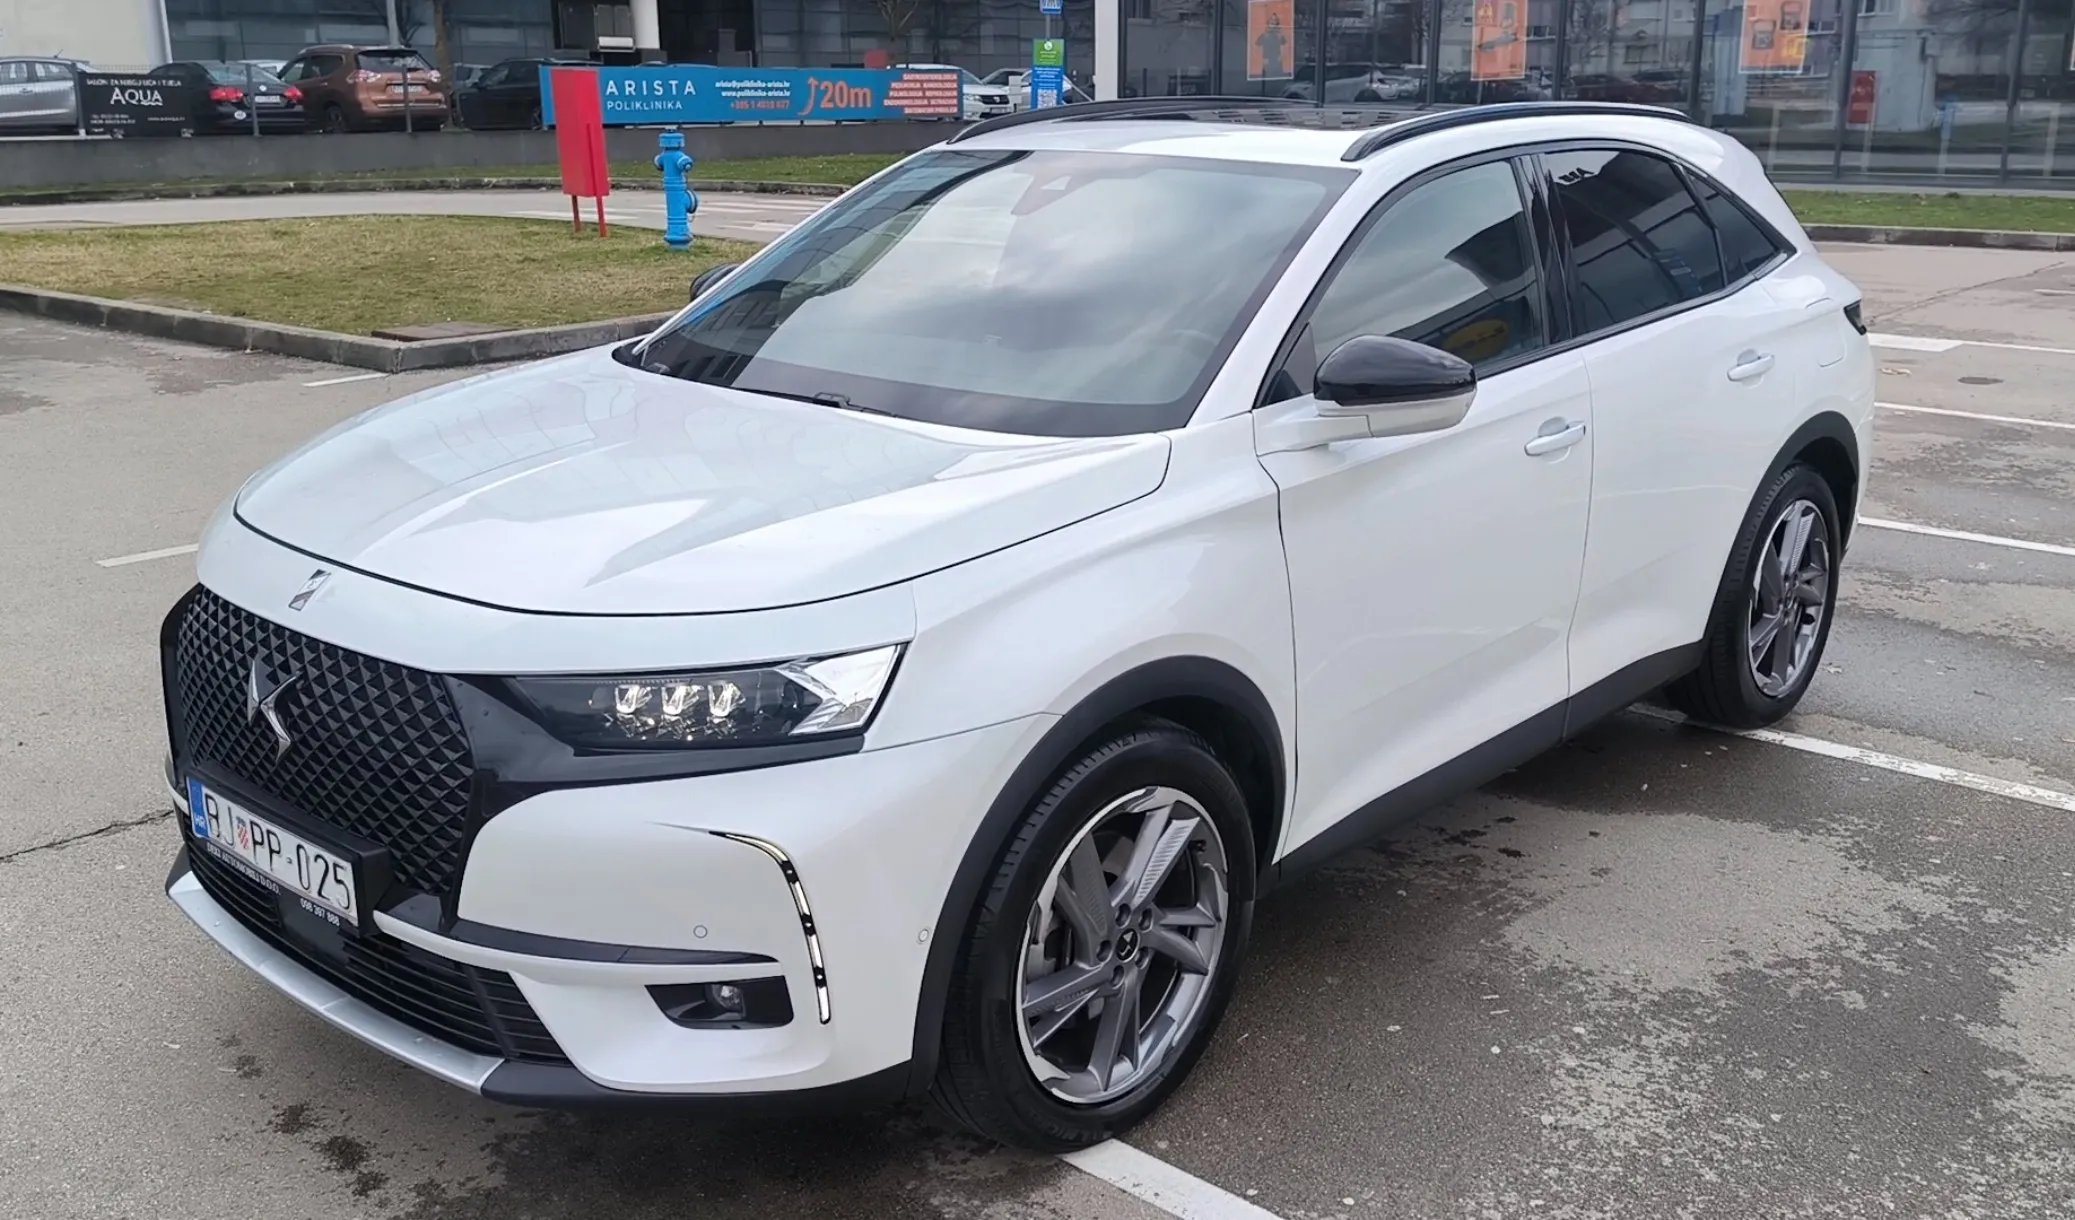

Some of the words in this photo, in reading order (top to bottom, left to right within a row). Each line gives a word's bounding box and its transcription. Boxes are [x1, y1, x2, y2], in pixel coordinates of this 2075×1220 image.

[110, 87, 163, 105] AQUA
[605, 79, 697, 96] ARISTA
[820, 81, 872, 109] 20m
[607, 101, 683, 111] POLIKLINIKA
[250, 819, 351, 910] PP-025
